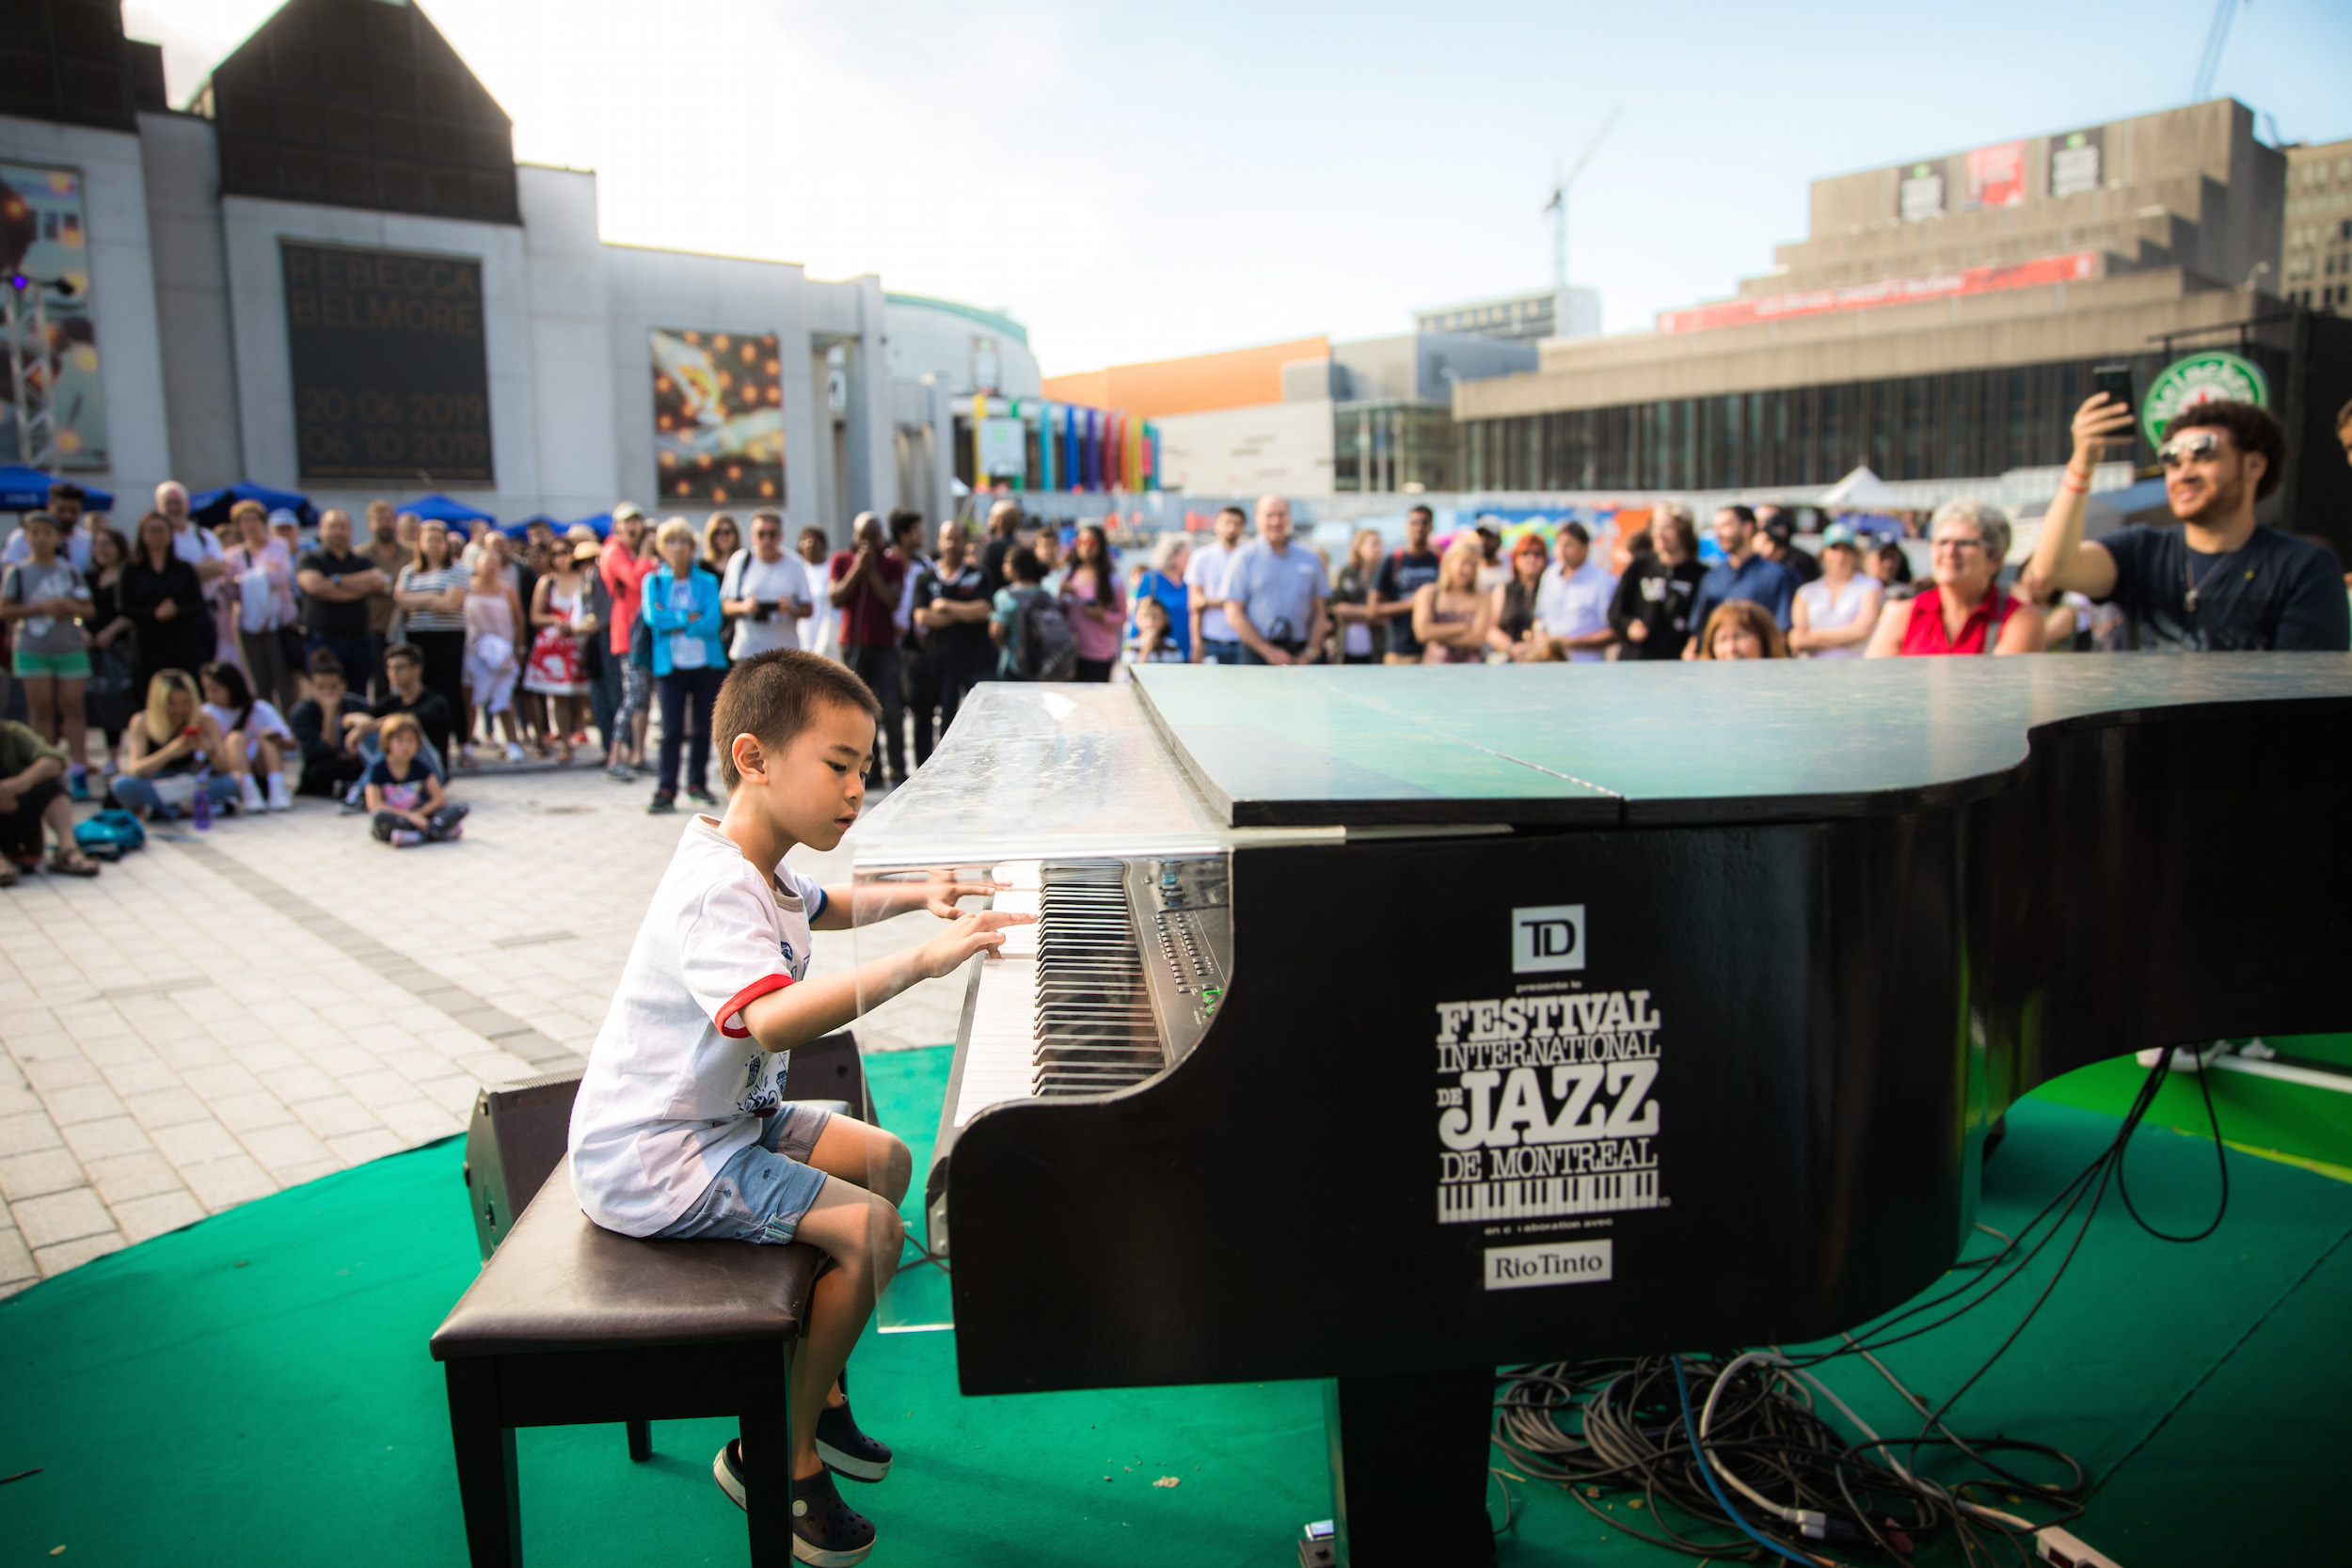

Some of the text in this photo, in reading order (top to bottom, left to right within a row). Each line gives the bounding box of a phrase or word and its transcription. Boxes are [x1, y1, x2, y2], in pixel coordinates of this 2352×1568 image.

[287, 250, 476, 296] REBECCA
[291, 290, 477, 337] BELMORE
[301, 387, 485, 426] 20 06 2019
[304, 423, 487, 464] 06 10 2019
[1520, 918, 1576, 958] TD
[1436, 990, 1661, 1044] FESTIVAL
[1437, 1031, 1661, 1073] INTERNATIONAL
[1437, 1087, 1464, 1108] DE
[1438, 1058, 1660, 1151] JAZZ
[1440, 1149, 1483, 1183] DE
